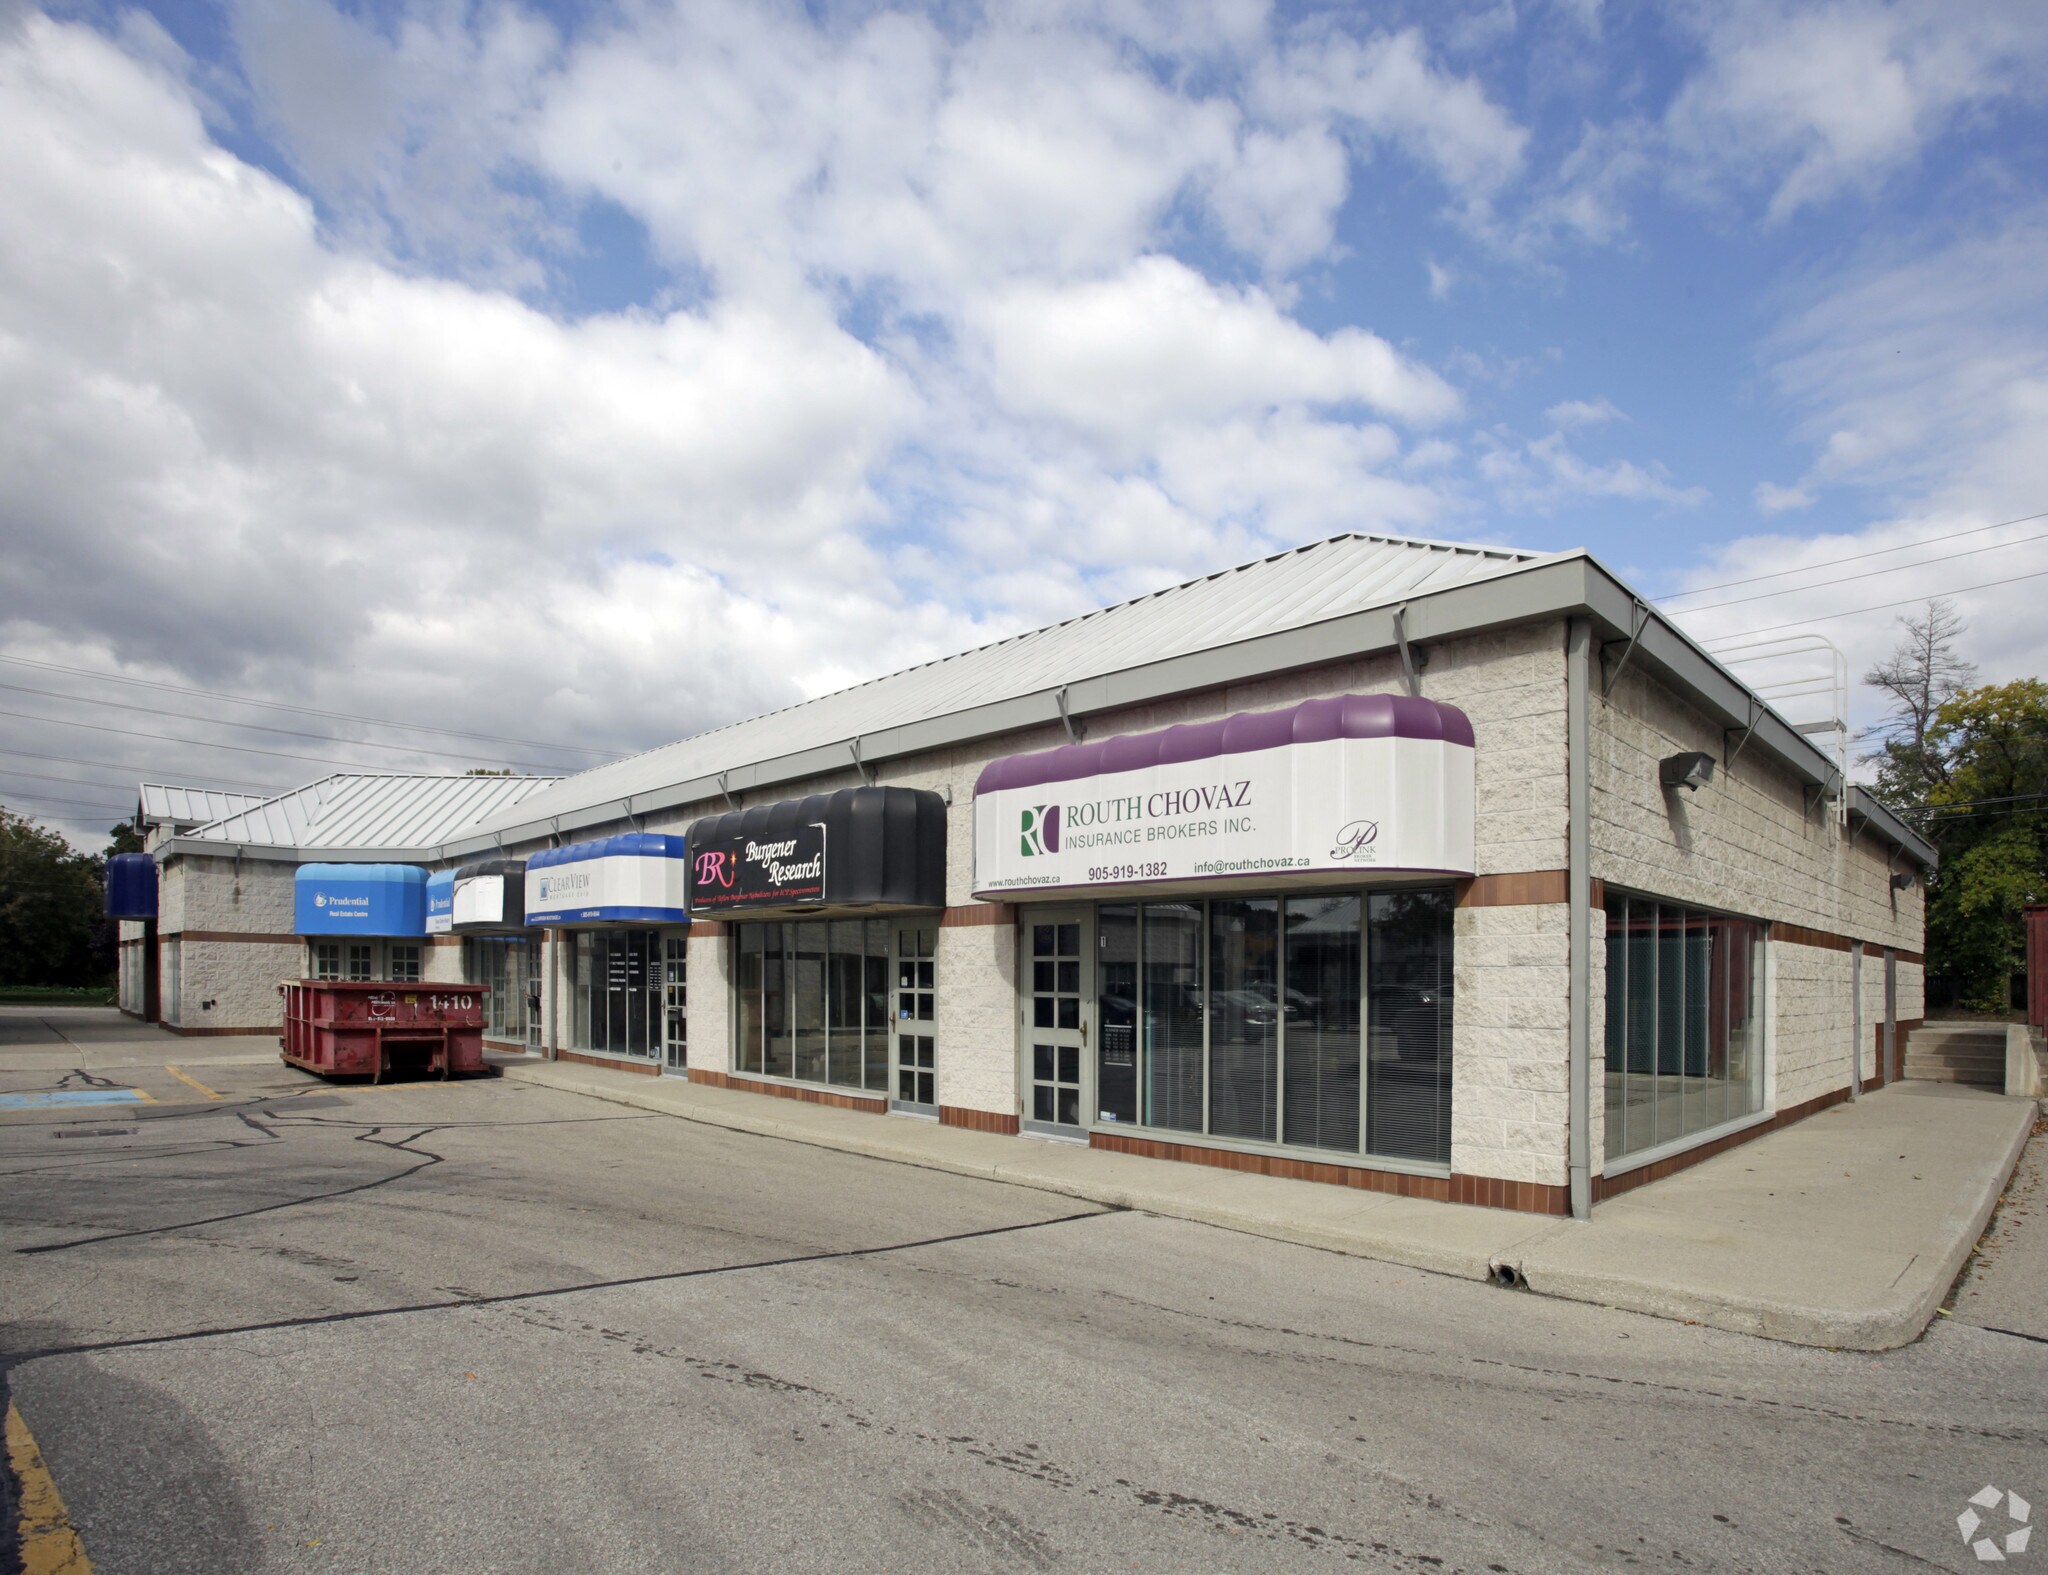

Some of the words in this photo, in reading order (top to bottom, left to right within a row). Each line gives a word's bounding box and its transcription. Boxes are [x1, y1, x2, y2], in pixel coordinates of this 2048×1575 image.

[1066, 795, 1143, 829] ROUTH
[1147, 780, 1252, 818] CHOVAZ
[1065, 828, 1142, 850] INSURANCE
[1147, 820, 1218, 842] BROKERS
[1224, 816, 1257, 834] INC.
[745, 839, 797, 869] Burgener
[768, 852, 821, 886] Research
[1088, 861, 1168, 881] 905-919-1382
[1194, 857, 1310, 875] info@routhchovaz.ca
[988, 874, 1061, 888] www.routhchovaz.ca
[329, 896, 369, 906] Prudential
[430, 994, 472, 1010] 1410
